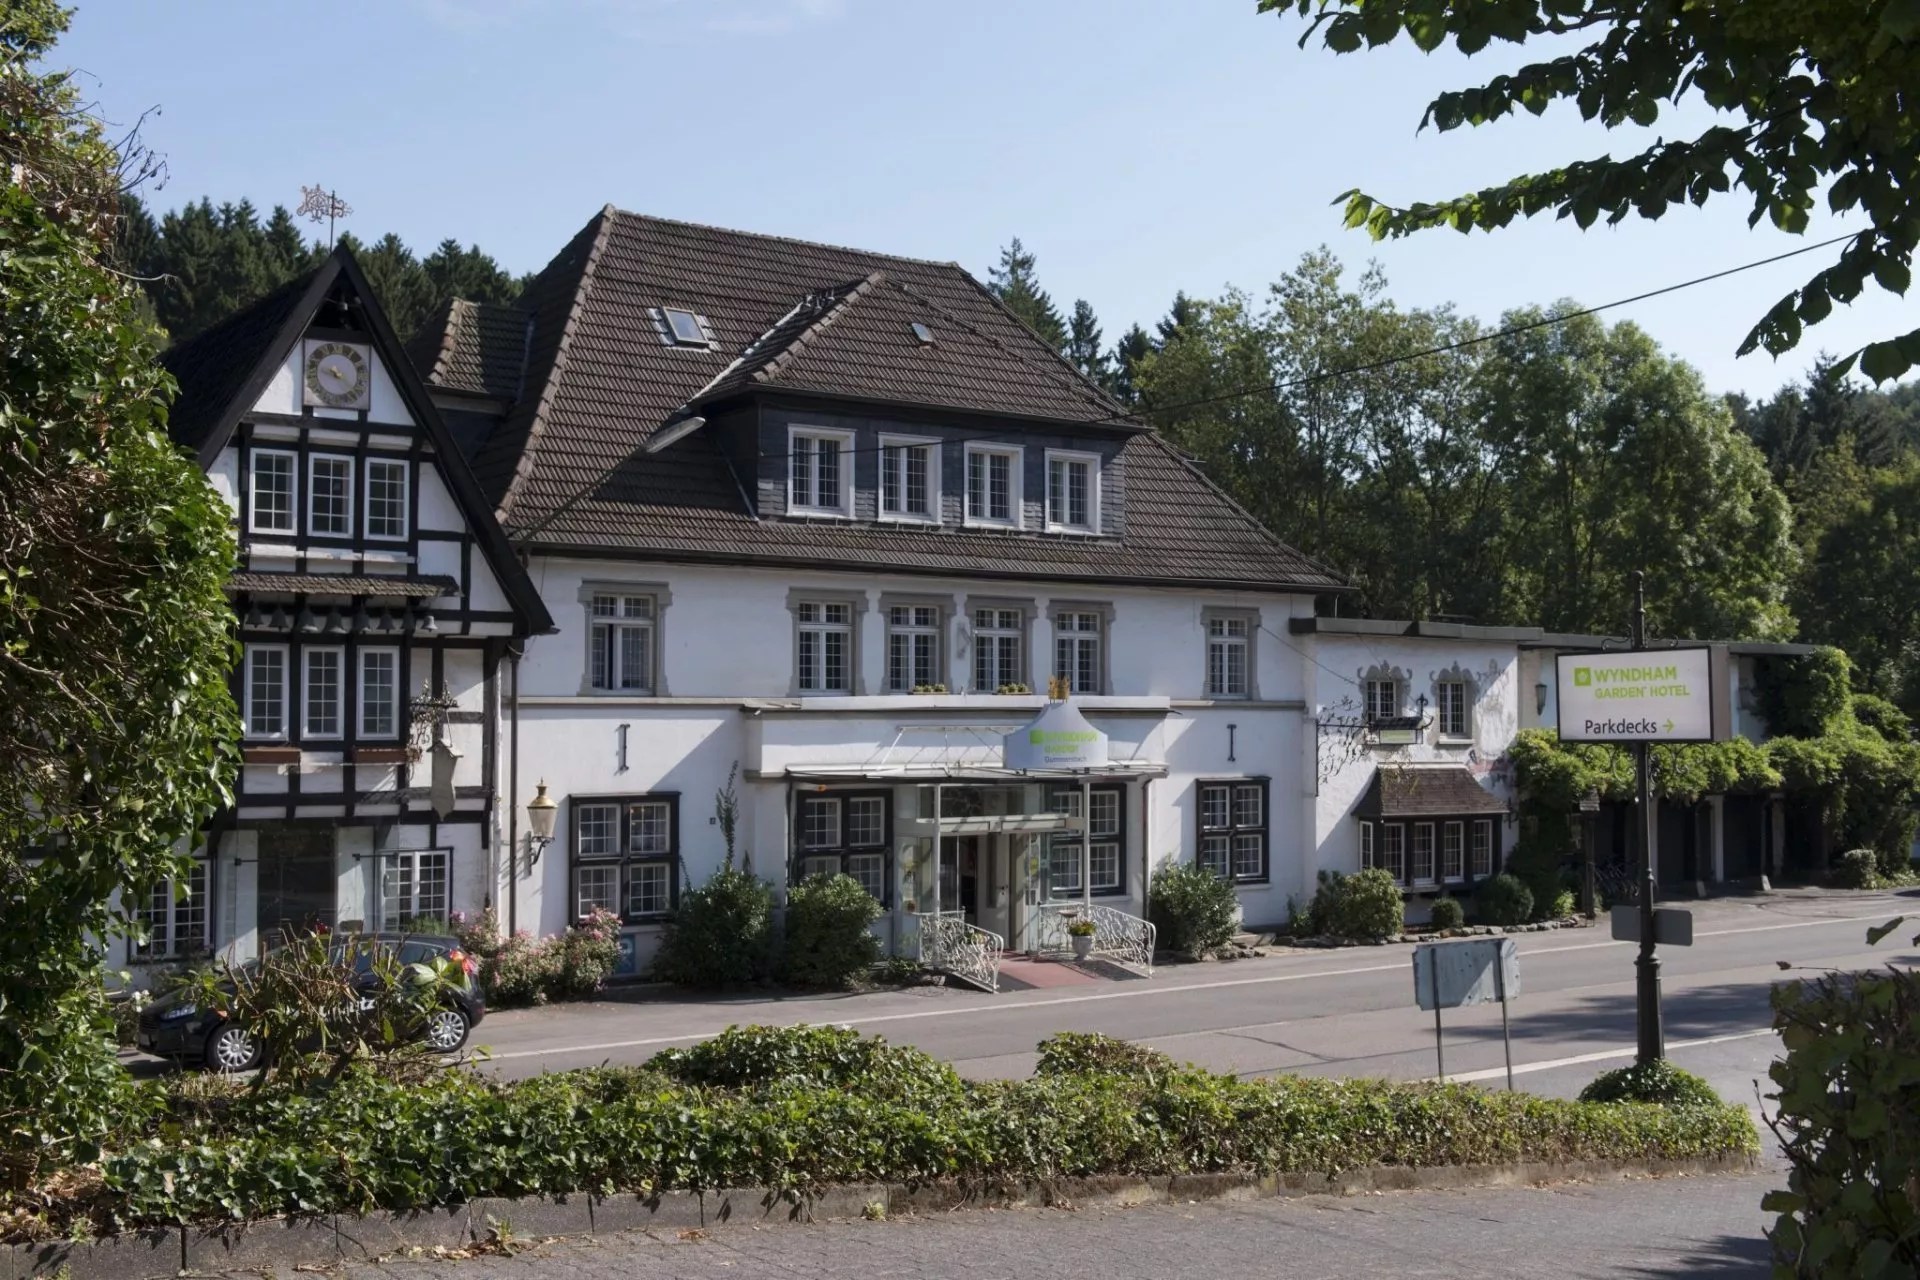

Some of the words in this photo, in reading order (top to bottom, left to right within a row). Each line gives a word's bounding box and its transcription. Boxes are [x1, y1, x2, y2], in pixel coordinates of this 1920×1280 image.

[1594, 666, 1677, 683] WYNDHAM
[1595, 687, 1645, 699] GARDEN
[1649, 685, 1690, 697] HOTEL
[1585, 717, 1657, 735] Parkdecks
